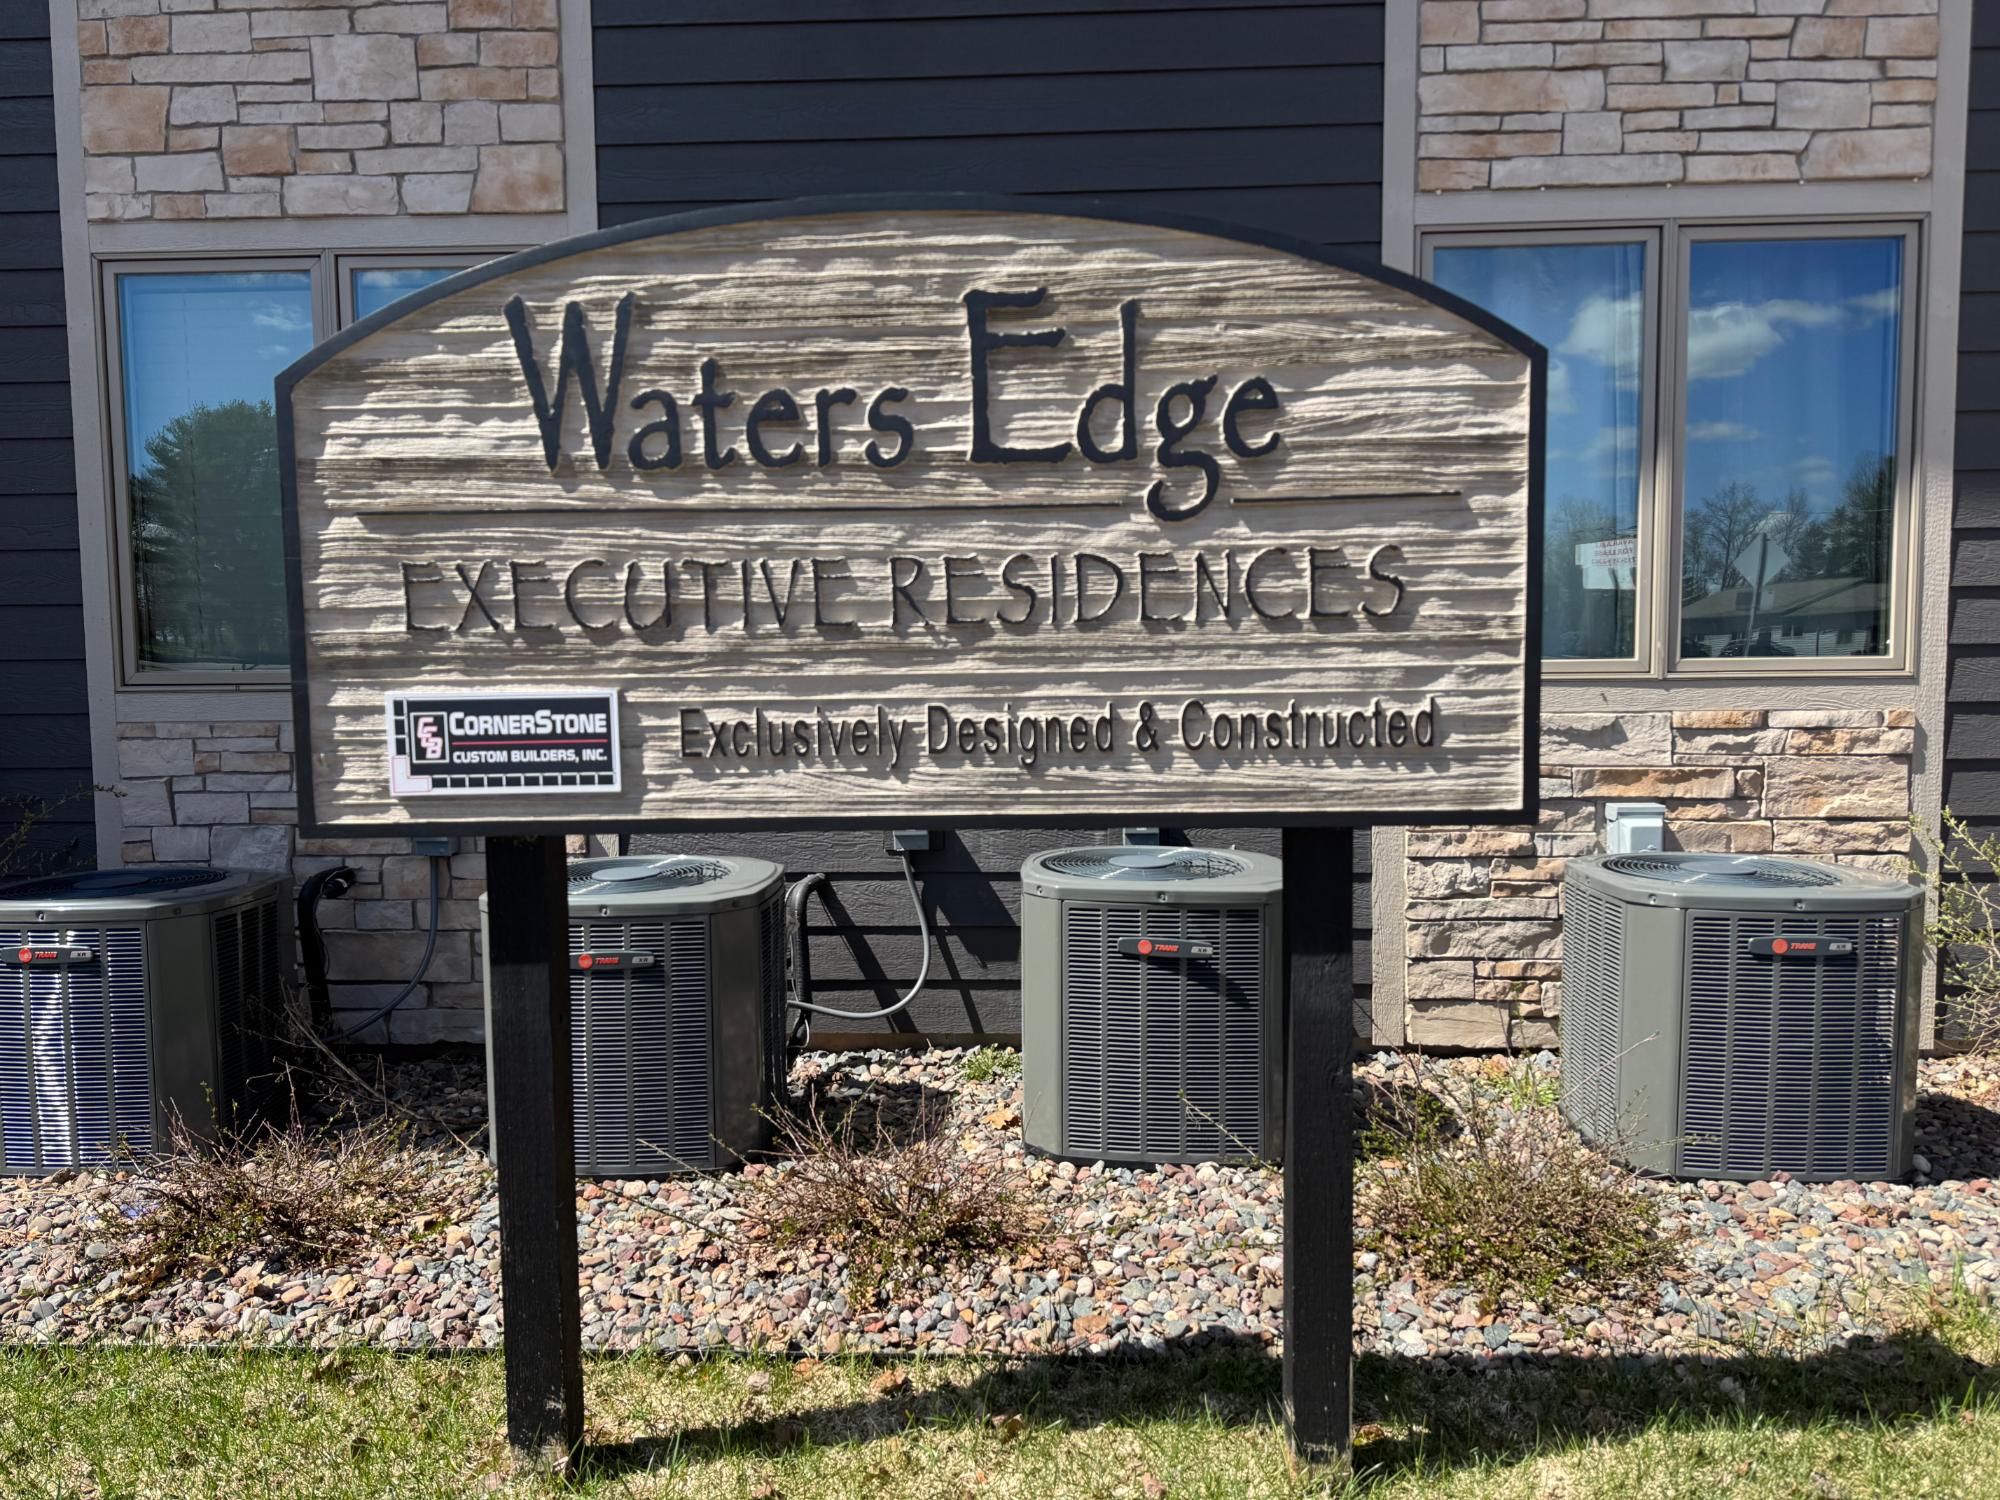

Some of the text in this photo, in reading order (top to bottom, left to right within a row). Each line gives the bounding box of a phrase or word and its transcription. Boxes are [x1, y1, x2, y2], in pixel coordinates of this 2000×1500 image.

[503, 286, 1281, 522] Waters Edge
[400, 544, 1405, 632] EXECUTIVE RESIDENCES
[452, 748, 608, 763] CUSTOM BUILDERS, INC.
[679, 695, 1435, 770] Exclusively Designed & Constructed
